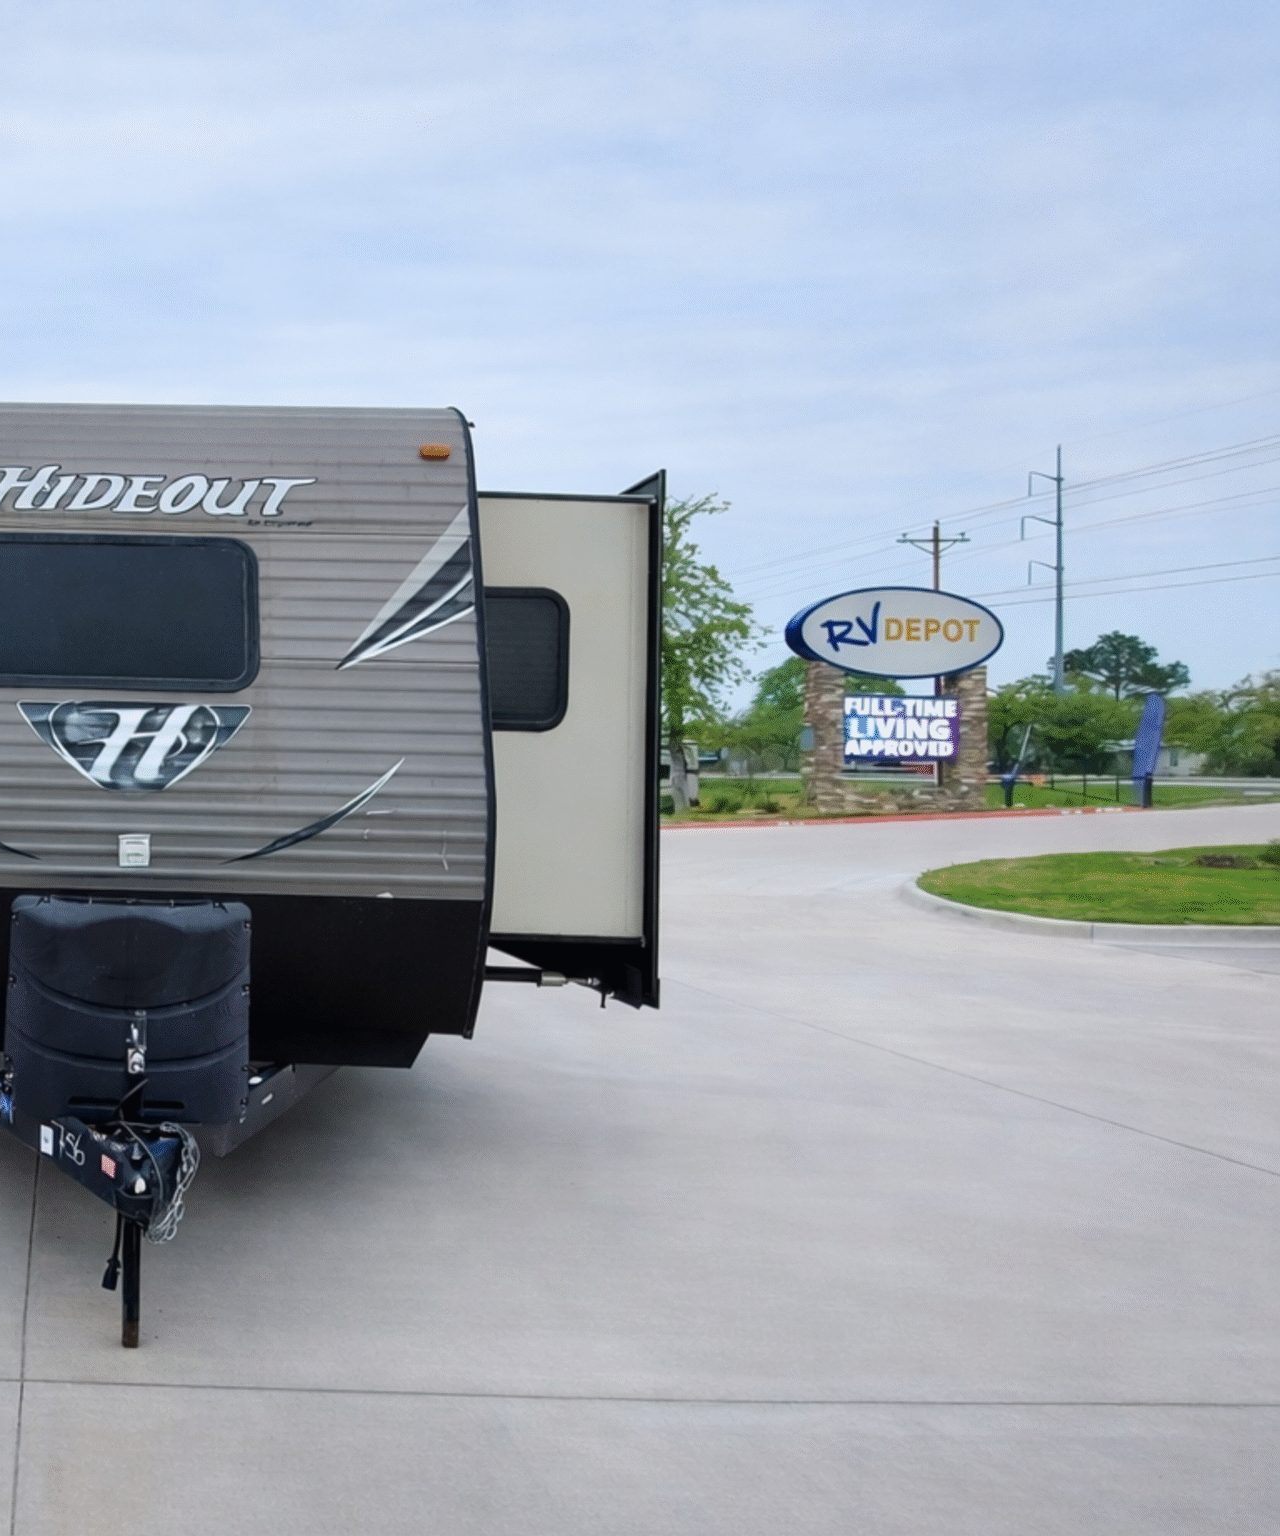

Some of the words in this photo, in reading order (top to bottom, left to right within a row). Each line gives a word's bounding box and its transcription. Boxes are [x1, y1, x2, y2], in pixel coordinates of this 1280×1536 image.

[820, 601, 881, 652] RV
[884, 618, 981, 643] DEPOT
[844, 697, 958, 718] FULL-TIME
[848, 718, 951, 740] LIVING
[77, 704, 201, 783] H
[844, 739, 955, 757] APPROVED
